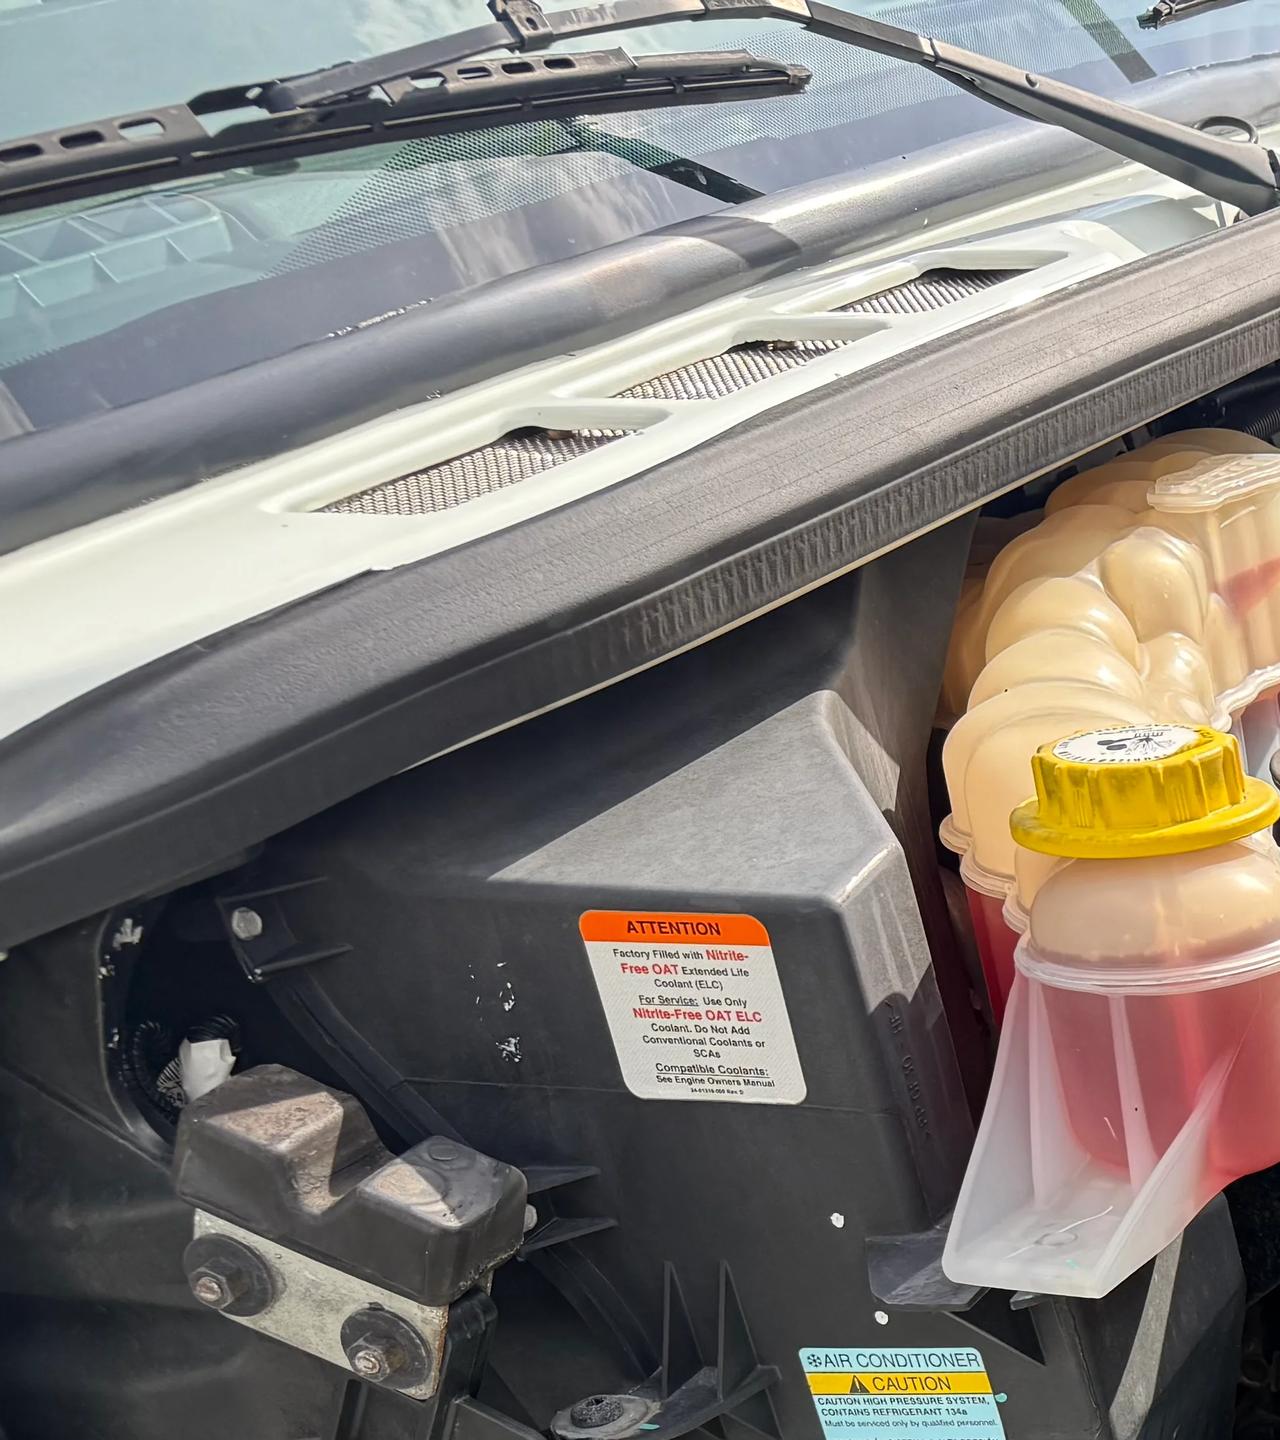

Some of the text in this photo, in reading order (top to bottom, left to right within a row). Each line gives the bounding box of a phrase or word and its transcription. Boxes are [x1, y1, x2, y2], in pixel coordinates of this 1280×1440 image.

[627, 921, 721, 936] ATTENTION
[613, 949, 748, 961] Factory Filled with Nitrite-
[621, 963, 749, 977] Free OAT Extended Life
[654, 979, 723, 991] Coolant (ELC)
[639, 995, 747, 1008] For Service: Use Only
[633, 1008, 762, 1022] Nitrite-Free OAT ELC
[651, 1024, 692, 1033] Coolant.
[711, 1026, 728, 1034] Not
[731, 1026, 750, 1035] Add
[643, 1036, 765, 1048] Conventional Coolants or
[694, 1050, 720, 1058] SCAs
[656, 1063, 769, 1077] Compatible Coolants:
[656, 1075, 775, 1087] See Engine Owners Manual
[824, 1353, 980, 1368] AIR CONDITIONER
[872, 1376, 952, 1391] CAUTION
[818, 1397, 989, 1406] CAUTION HIGH PRESSURE SYSTEM,
[873, 1408, 942, 1416] REFRIGERANT
[946, 1408, 968, 1416] 134a
[892, 1420, 908, 1429] only
[911, 1420, 920, 1428] by
[922, 1419, 954, 1428] qualified
